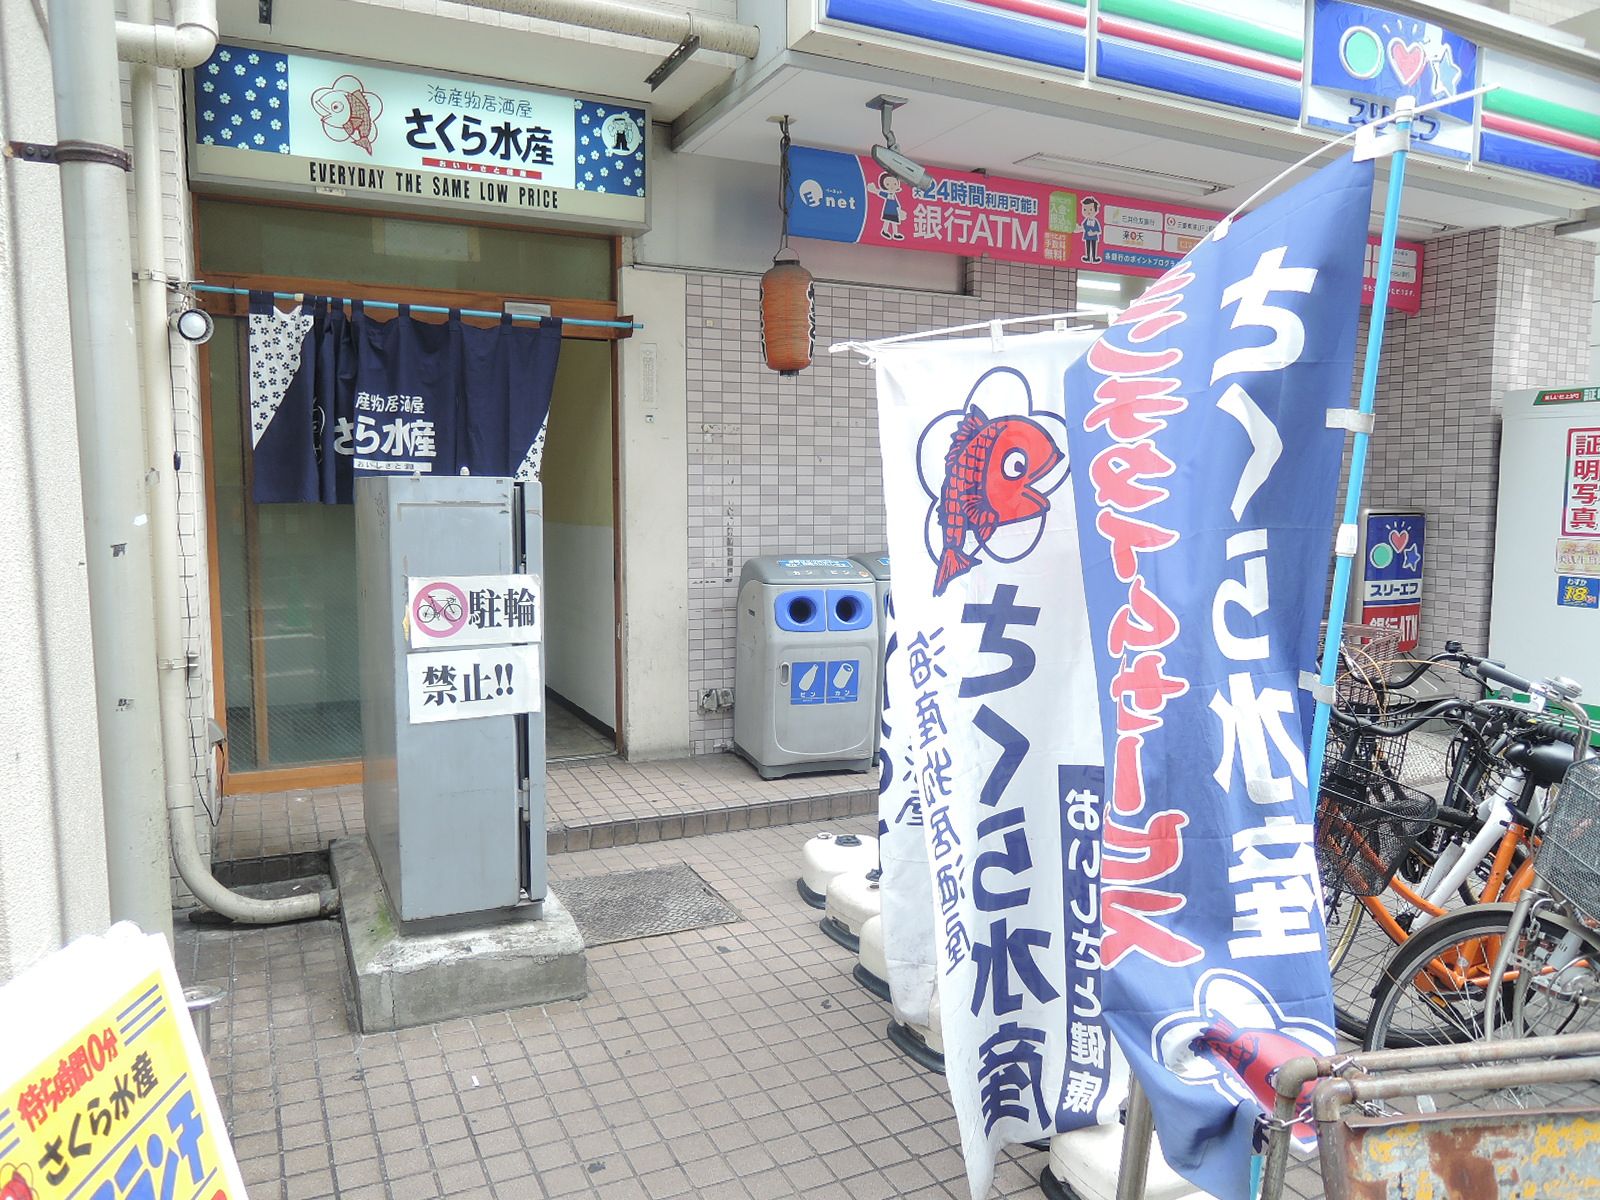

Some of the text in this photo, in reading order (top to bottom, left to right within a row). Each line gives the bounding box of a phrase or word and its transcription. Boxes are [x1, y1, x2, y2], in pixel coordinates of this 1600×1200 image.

[427, 83, 534, 119] 海産物居酒屋
[405, 108, 555, 166] さくら水産
[309, 161, 558, 209] EVERYDAY THE SAME LOW PRICE
[825, 196, 856, 210] net
[913, 204, 1038, 252] 銀行ATM
[1104, 251, 1180, 268] 各銀行のポイントプログラ
[1570, 434, 1600, 530] 証明写真
[469, 588, 536, 629] 駐輪
[1370, 582, 1419, 598] スリーエフ
[422, 663, 514, 707] 禁止!!
[17, 1027, 119, 1133] 待ち時間0分
[38, 1051, 158, 1186] さくら水産
